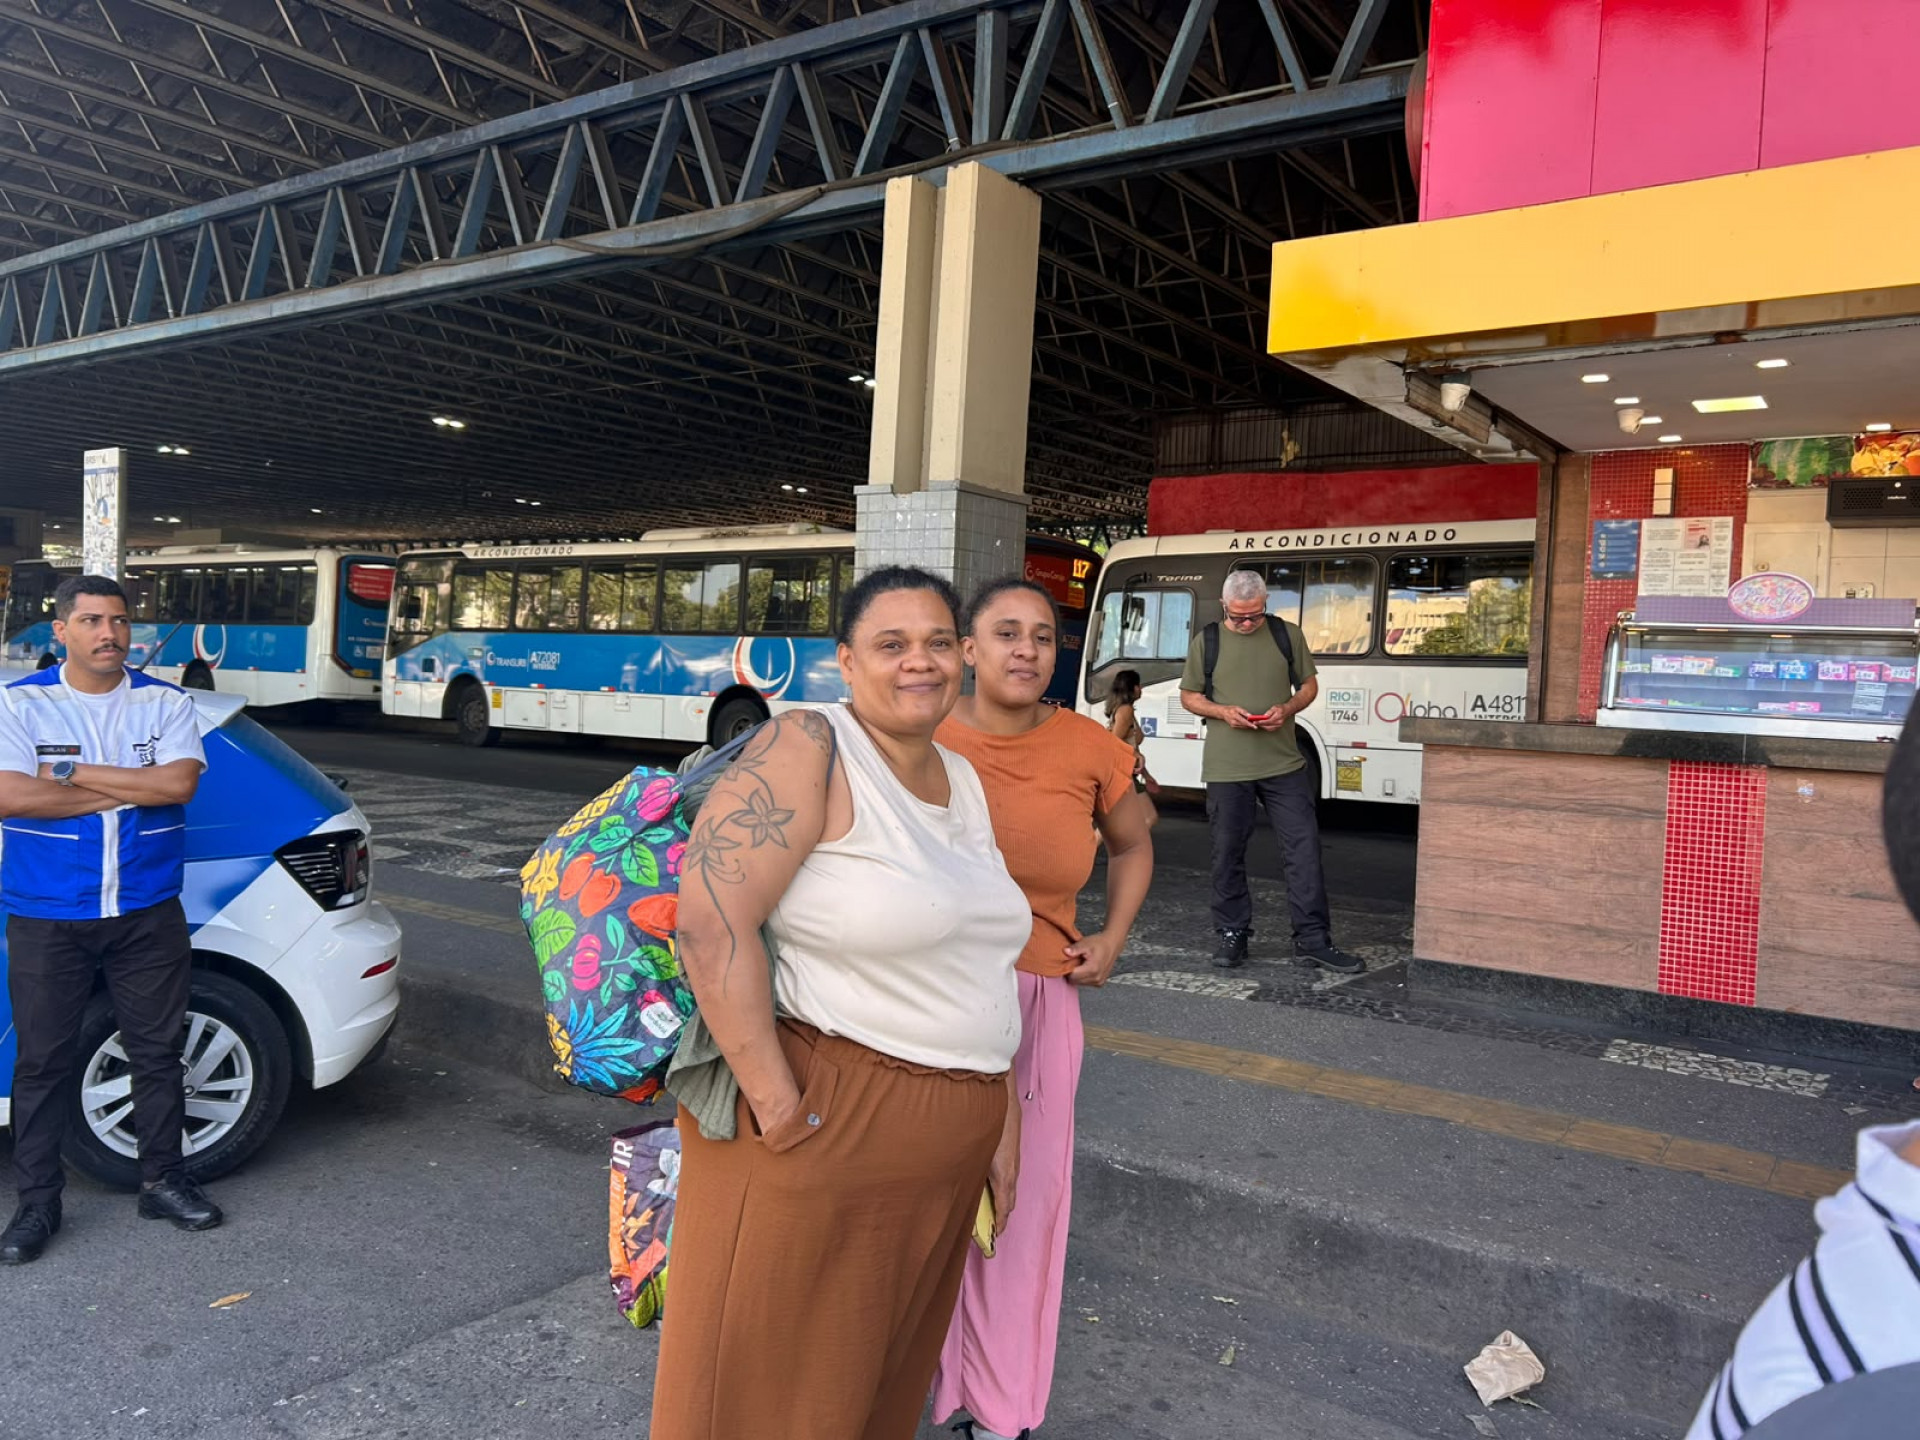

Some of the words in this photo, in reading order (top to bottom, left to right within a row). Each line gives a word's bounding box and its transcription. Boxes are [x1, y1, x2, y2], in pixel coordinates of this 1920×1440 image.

[1229, 537, 1255, 550] AR
[1263, 528, 1457, 548] CONDICIONADO
[473, 548, 486, 557] AR
[488, 546, 573, 557] CONDICIONADO
[1330, 691, 1351, 702] RIO
[1331, 710, 1358, 722] 1746
